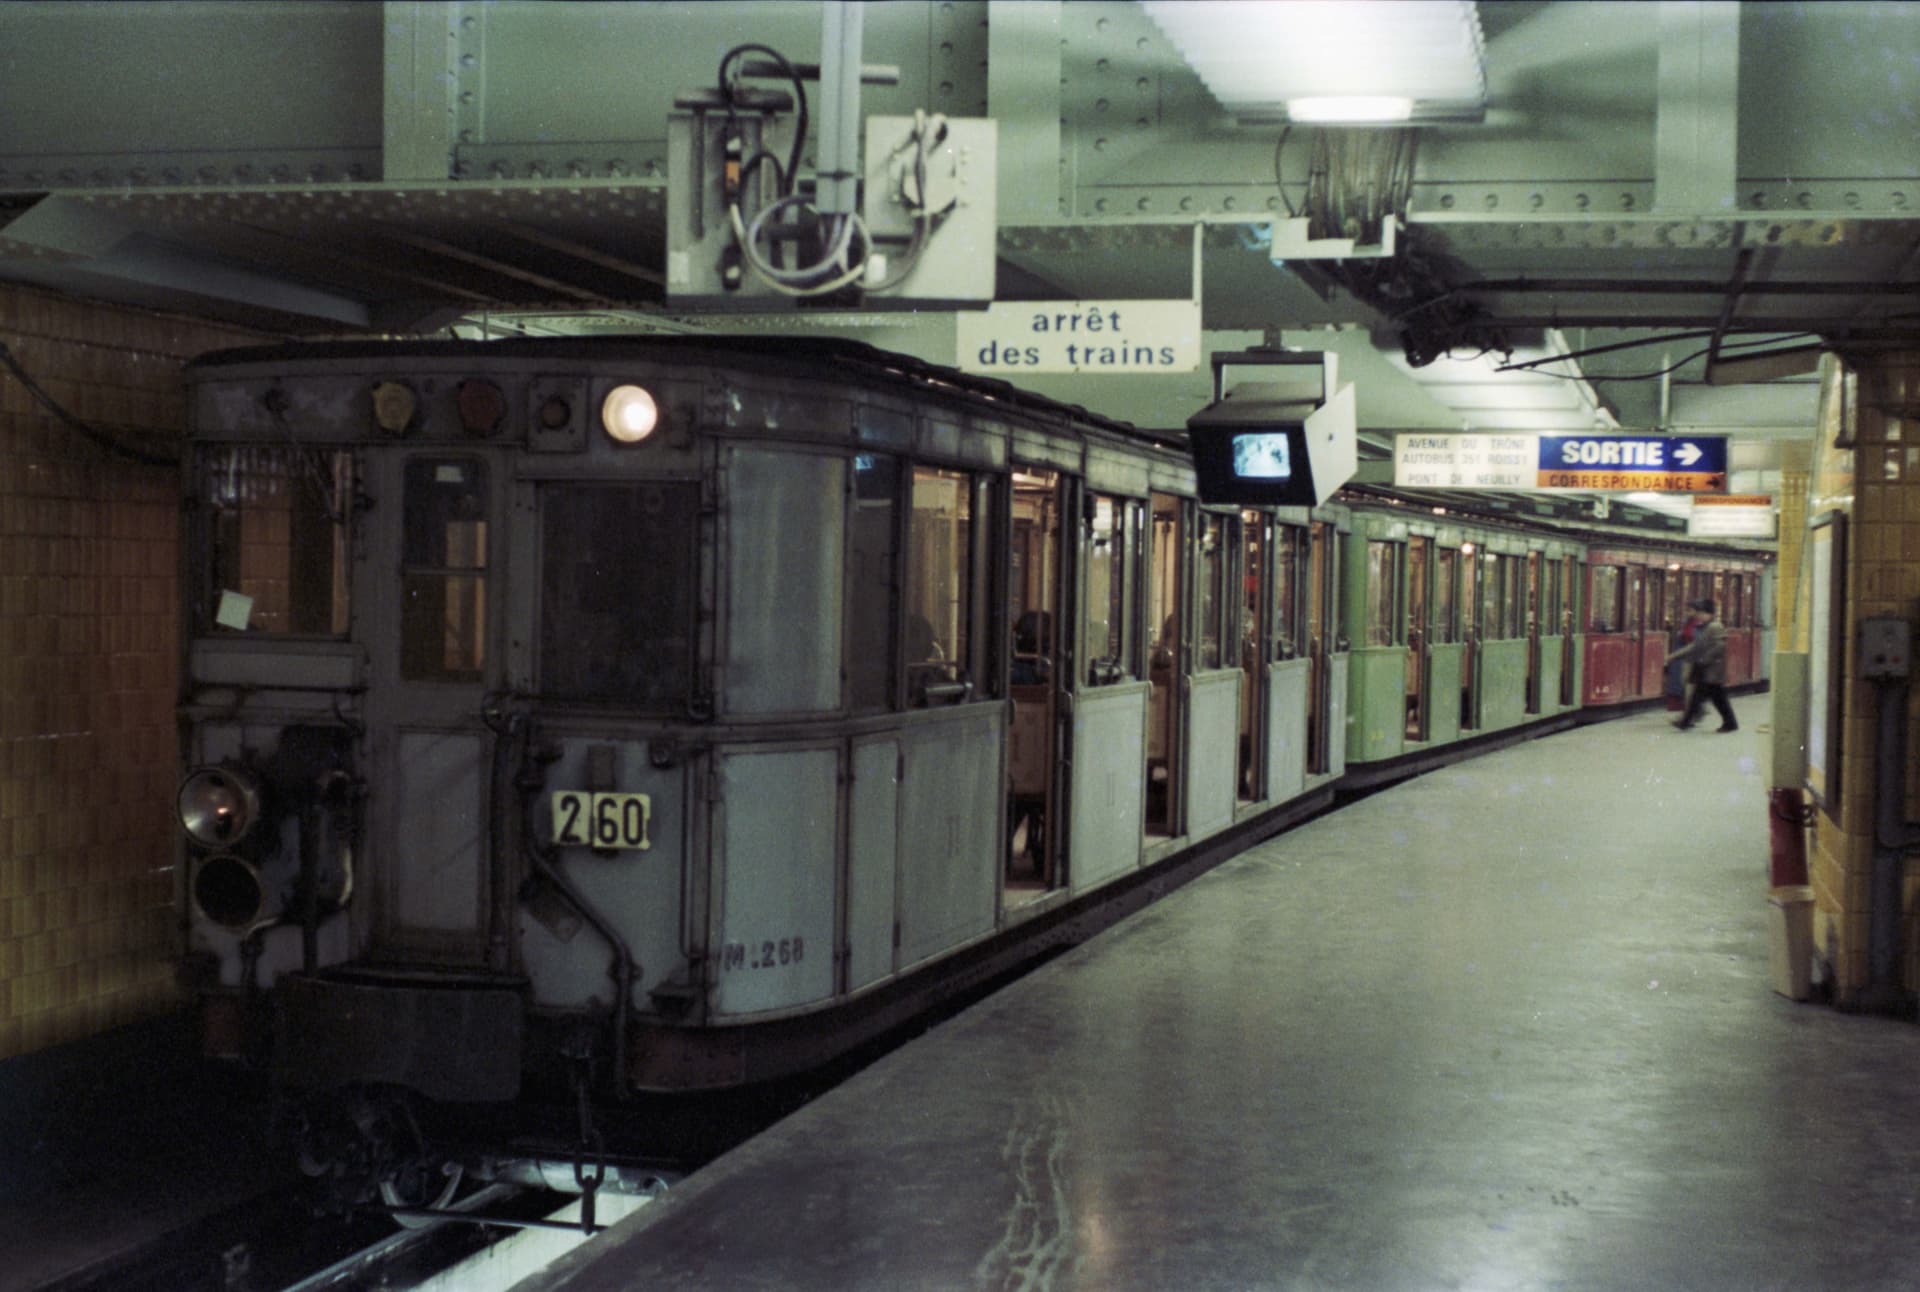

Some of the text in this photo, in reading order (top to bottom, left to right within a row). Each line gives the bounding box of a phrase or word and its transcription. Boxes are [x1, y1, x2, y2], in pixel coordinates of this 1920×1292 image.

[1031, 307, 1122, 332] arrêt
[978, 339, 1176, 365] des trains
[1407, 437, 1449, 449] AVENUE
[1461, 438, 1478, 449] DU
[1402, 453, 1455, 464] AUTOBUS
[1561, 440, 1664, 465] SORTIE
[1408, 473, 1438, 485] PONT
[1476, 473, 1520, 485] NEUILLY
[1549, 473, 1693, 489] CORRESPONDANCE
